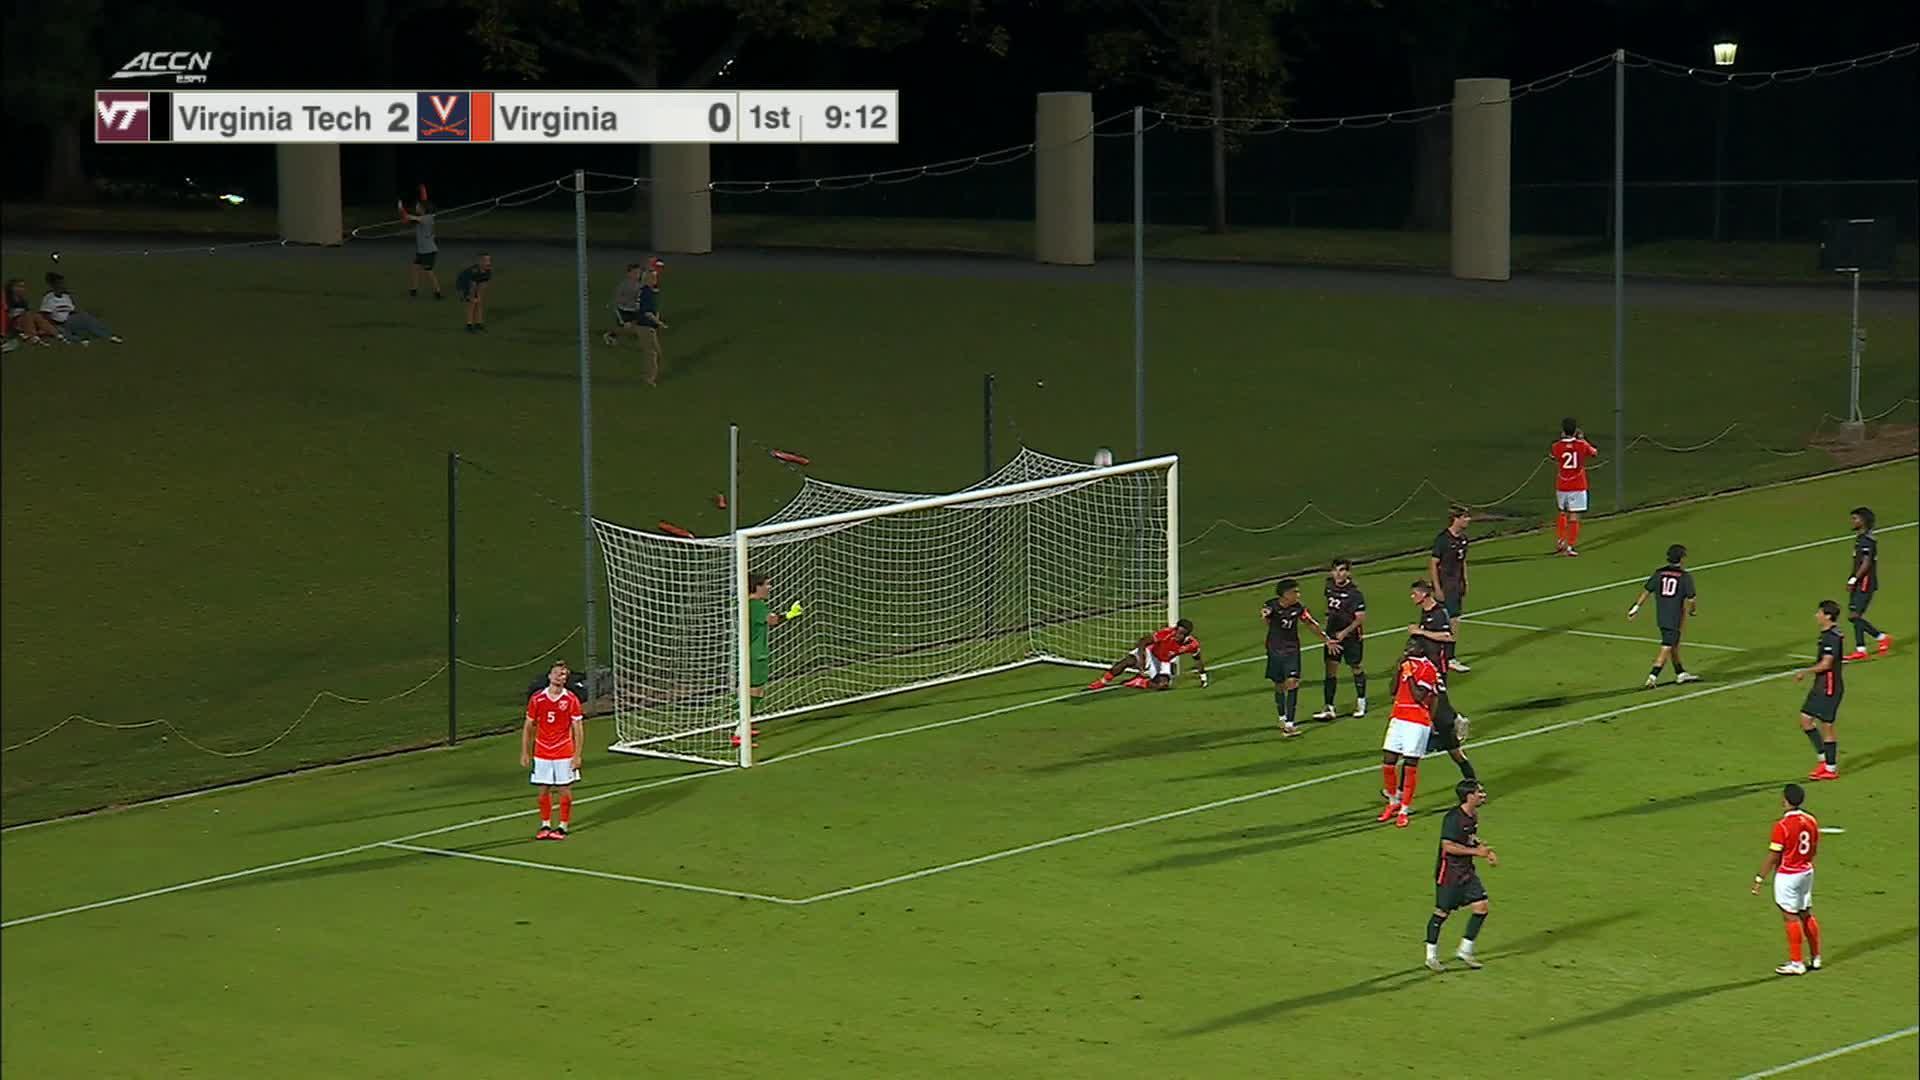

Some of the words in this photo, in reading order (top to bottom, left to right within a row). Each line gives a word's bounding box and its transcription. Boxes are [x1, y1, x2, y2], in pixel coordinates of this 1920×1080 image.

[1562, 452, 1577, 469] 21
[1662, 577, 1677, 596] 10
[1328, 597, 1341, 609] 22
[547, 711, 555, 723] 5
[1798, 831, 1810, 854] 8
